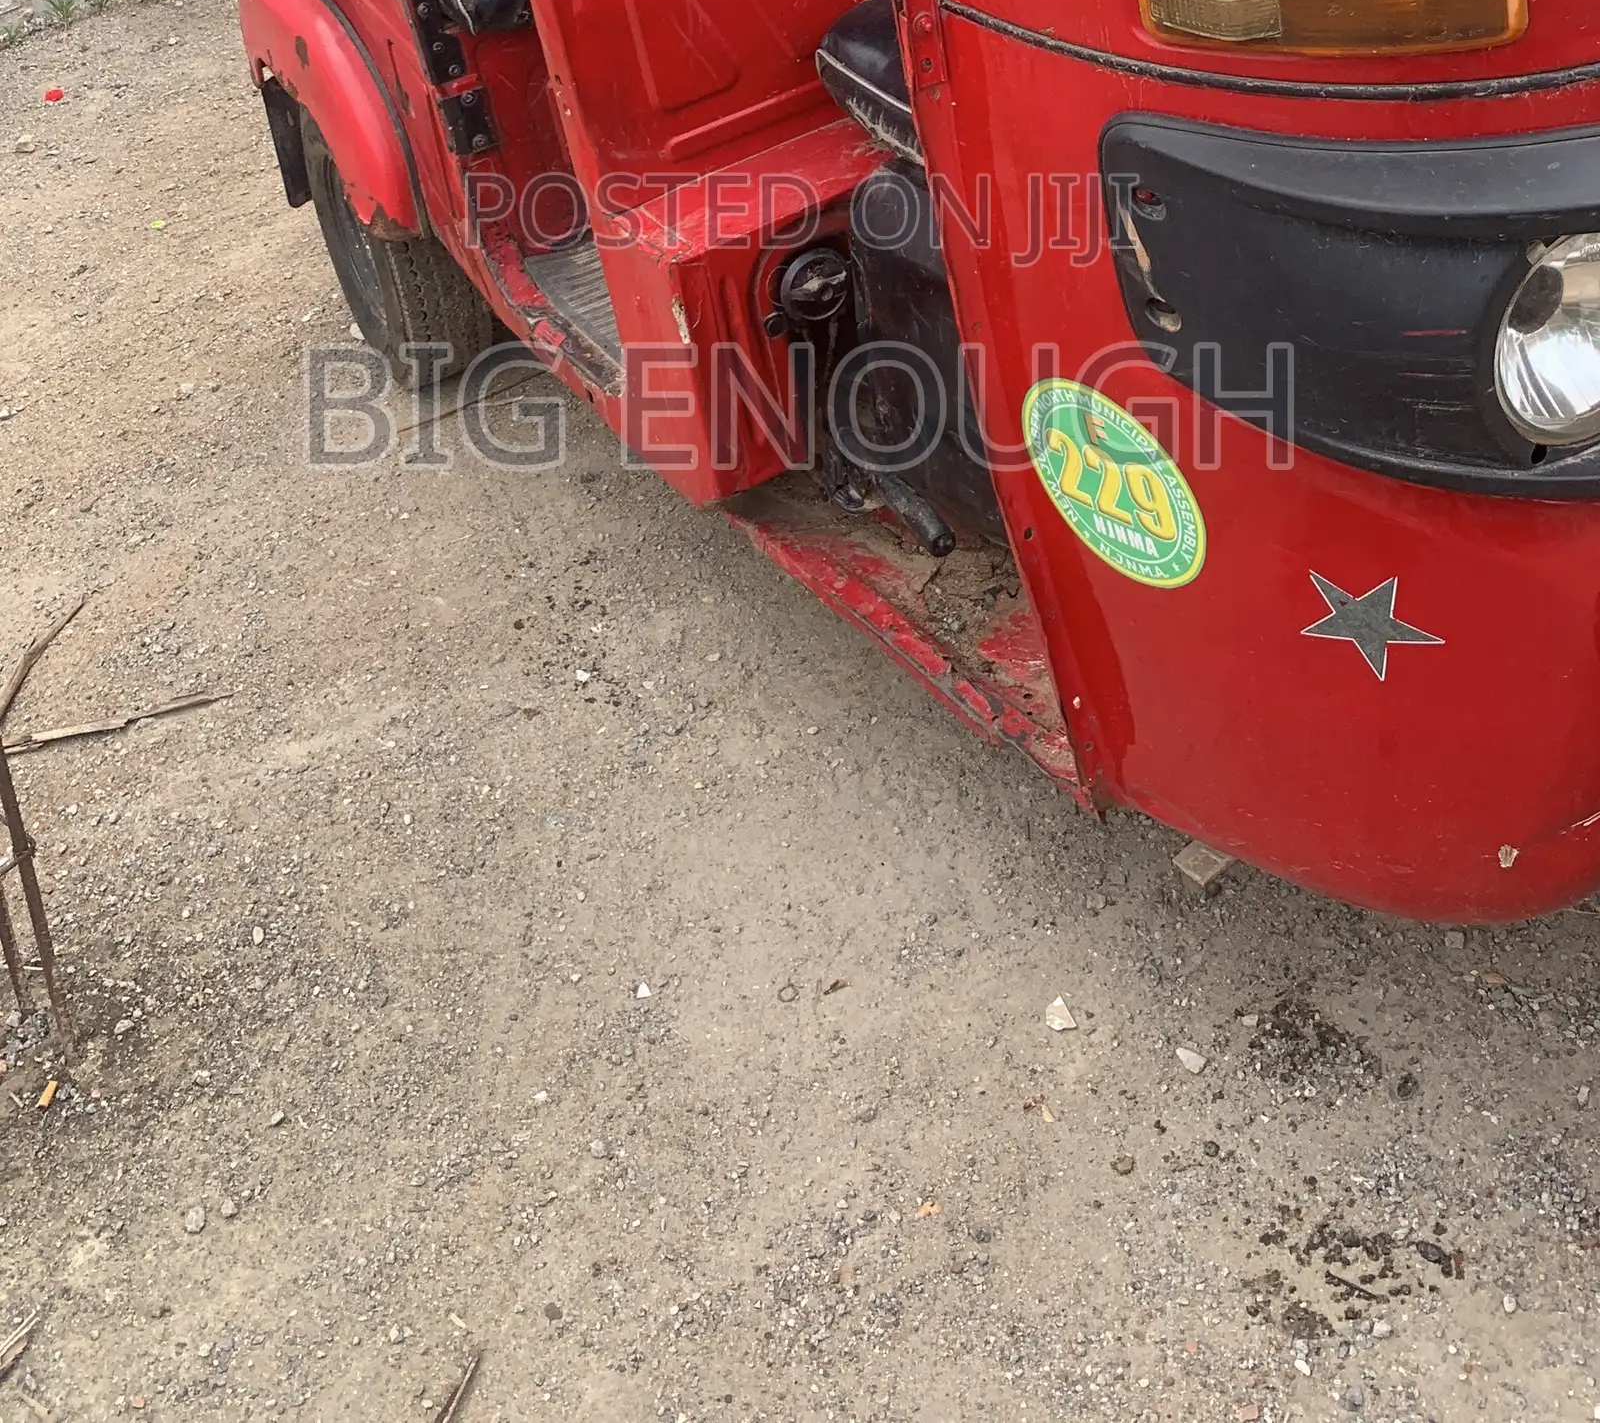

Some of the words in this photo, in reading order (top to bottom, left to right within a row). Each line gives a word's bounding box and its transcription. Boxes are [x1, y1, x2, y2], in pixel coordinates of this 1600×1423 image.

[1030, 402, 1052, 476] JUABEN
[1037, 389, 1077, 415] NORTH
[1077, 391, 1166, 472] MUNICIPAL
[1046, 428, 1177, 543] 229
[1047, 479, 1079, 523] NEW
[1163, 473, 1197, 565] ASSEMBLY
